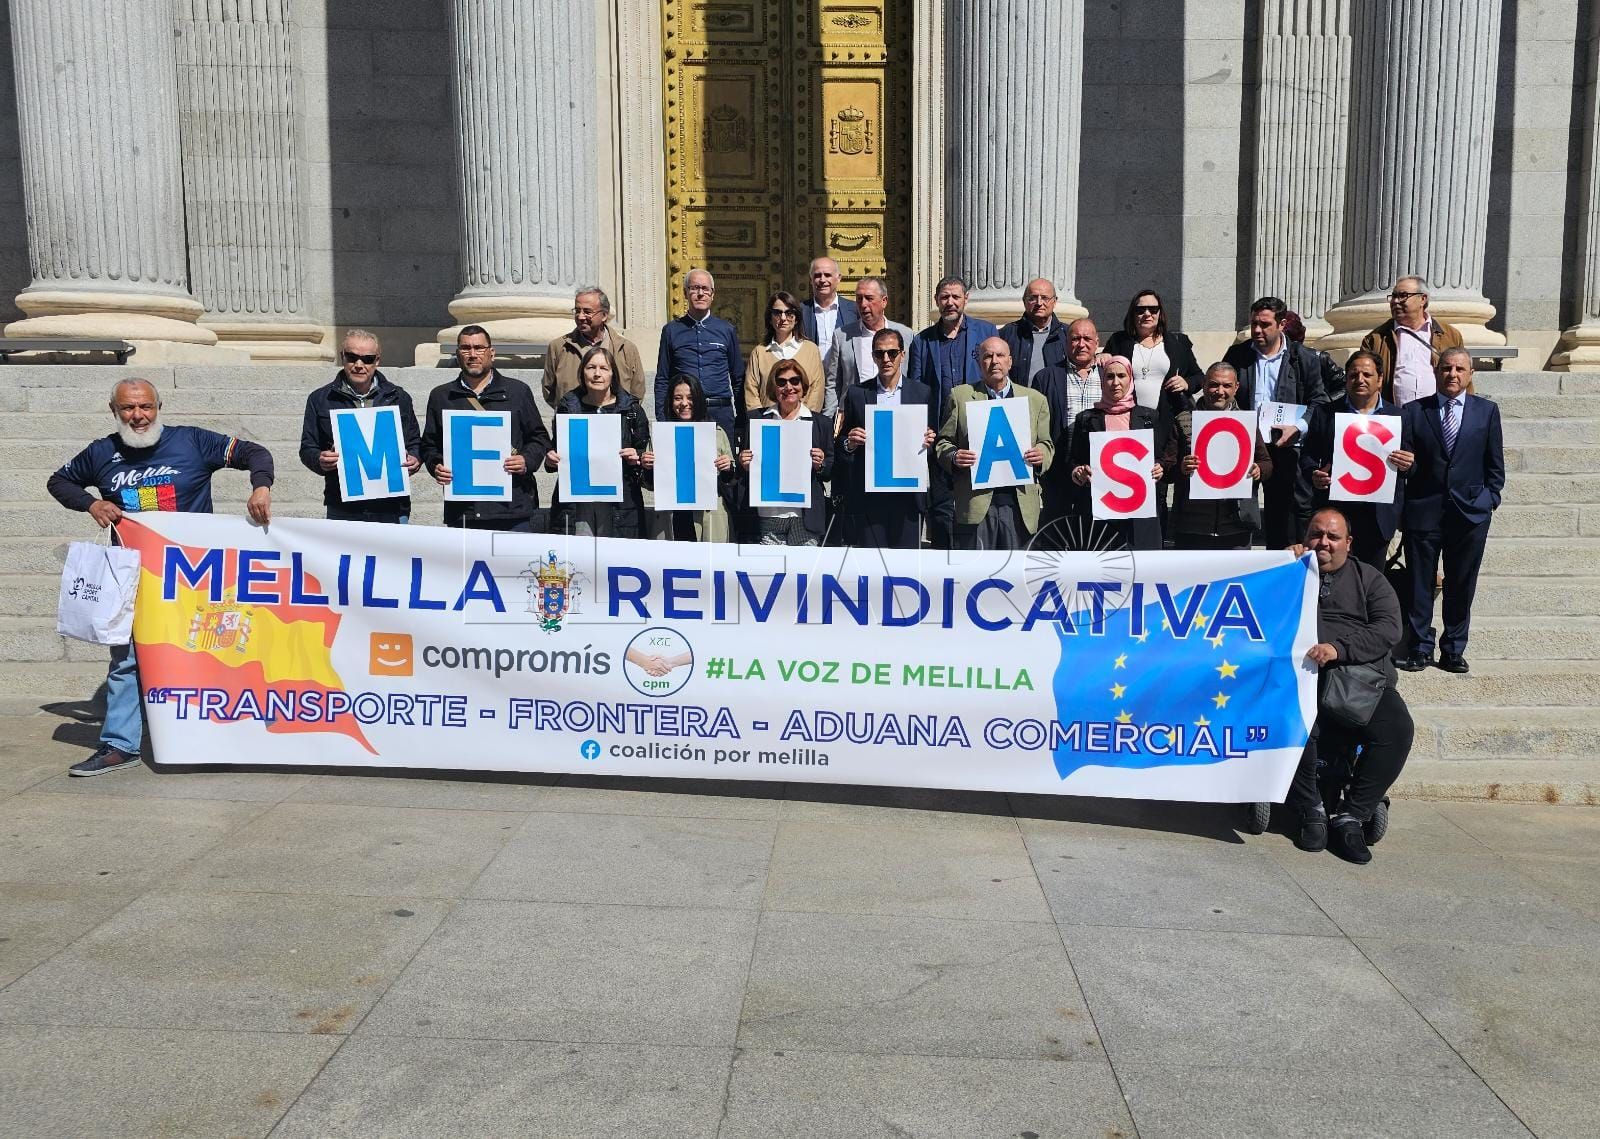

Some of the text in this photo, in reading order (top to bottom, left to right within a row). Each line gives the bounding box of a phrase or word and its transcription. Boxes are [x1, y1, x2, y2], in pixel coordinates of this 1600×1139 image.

[110, 465, 182, 491] Melilla
[142, 475, 172, 487] 2023
[163, 546, 1266, 642] MELILLA REIVINDICATIVA
[423, 643, 611, 679] compromís
[706, 657, 1034, 691] #LA VOZ DE MELILLA
[643, 680, 670, 690] cpm
[509, 697, 741, 739] FRONTERA
[780, 709, 971, 748] ADUANA
[609, 740, 831, 767] coalición por melilla
